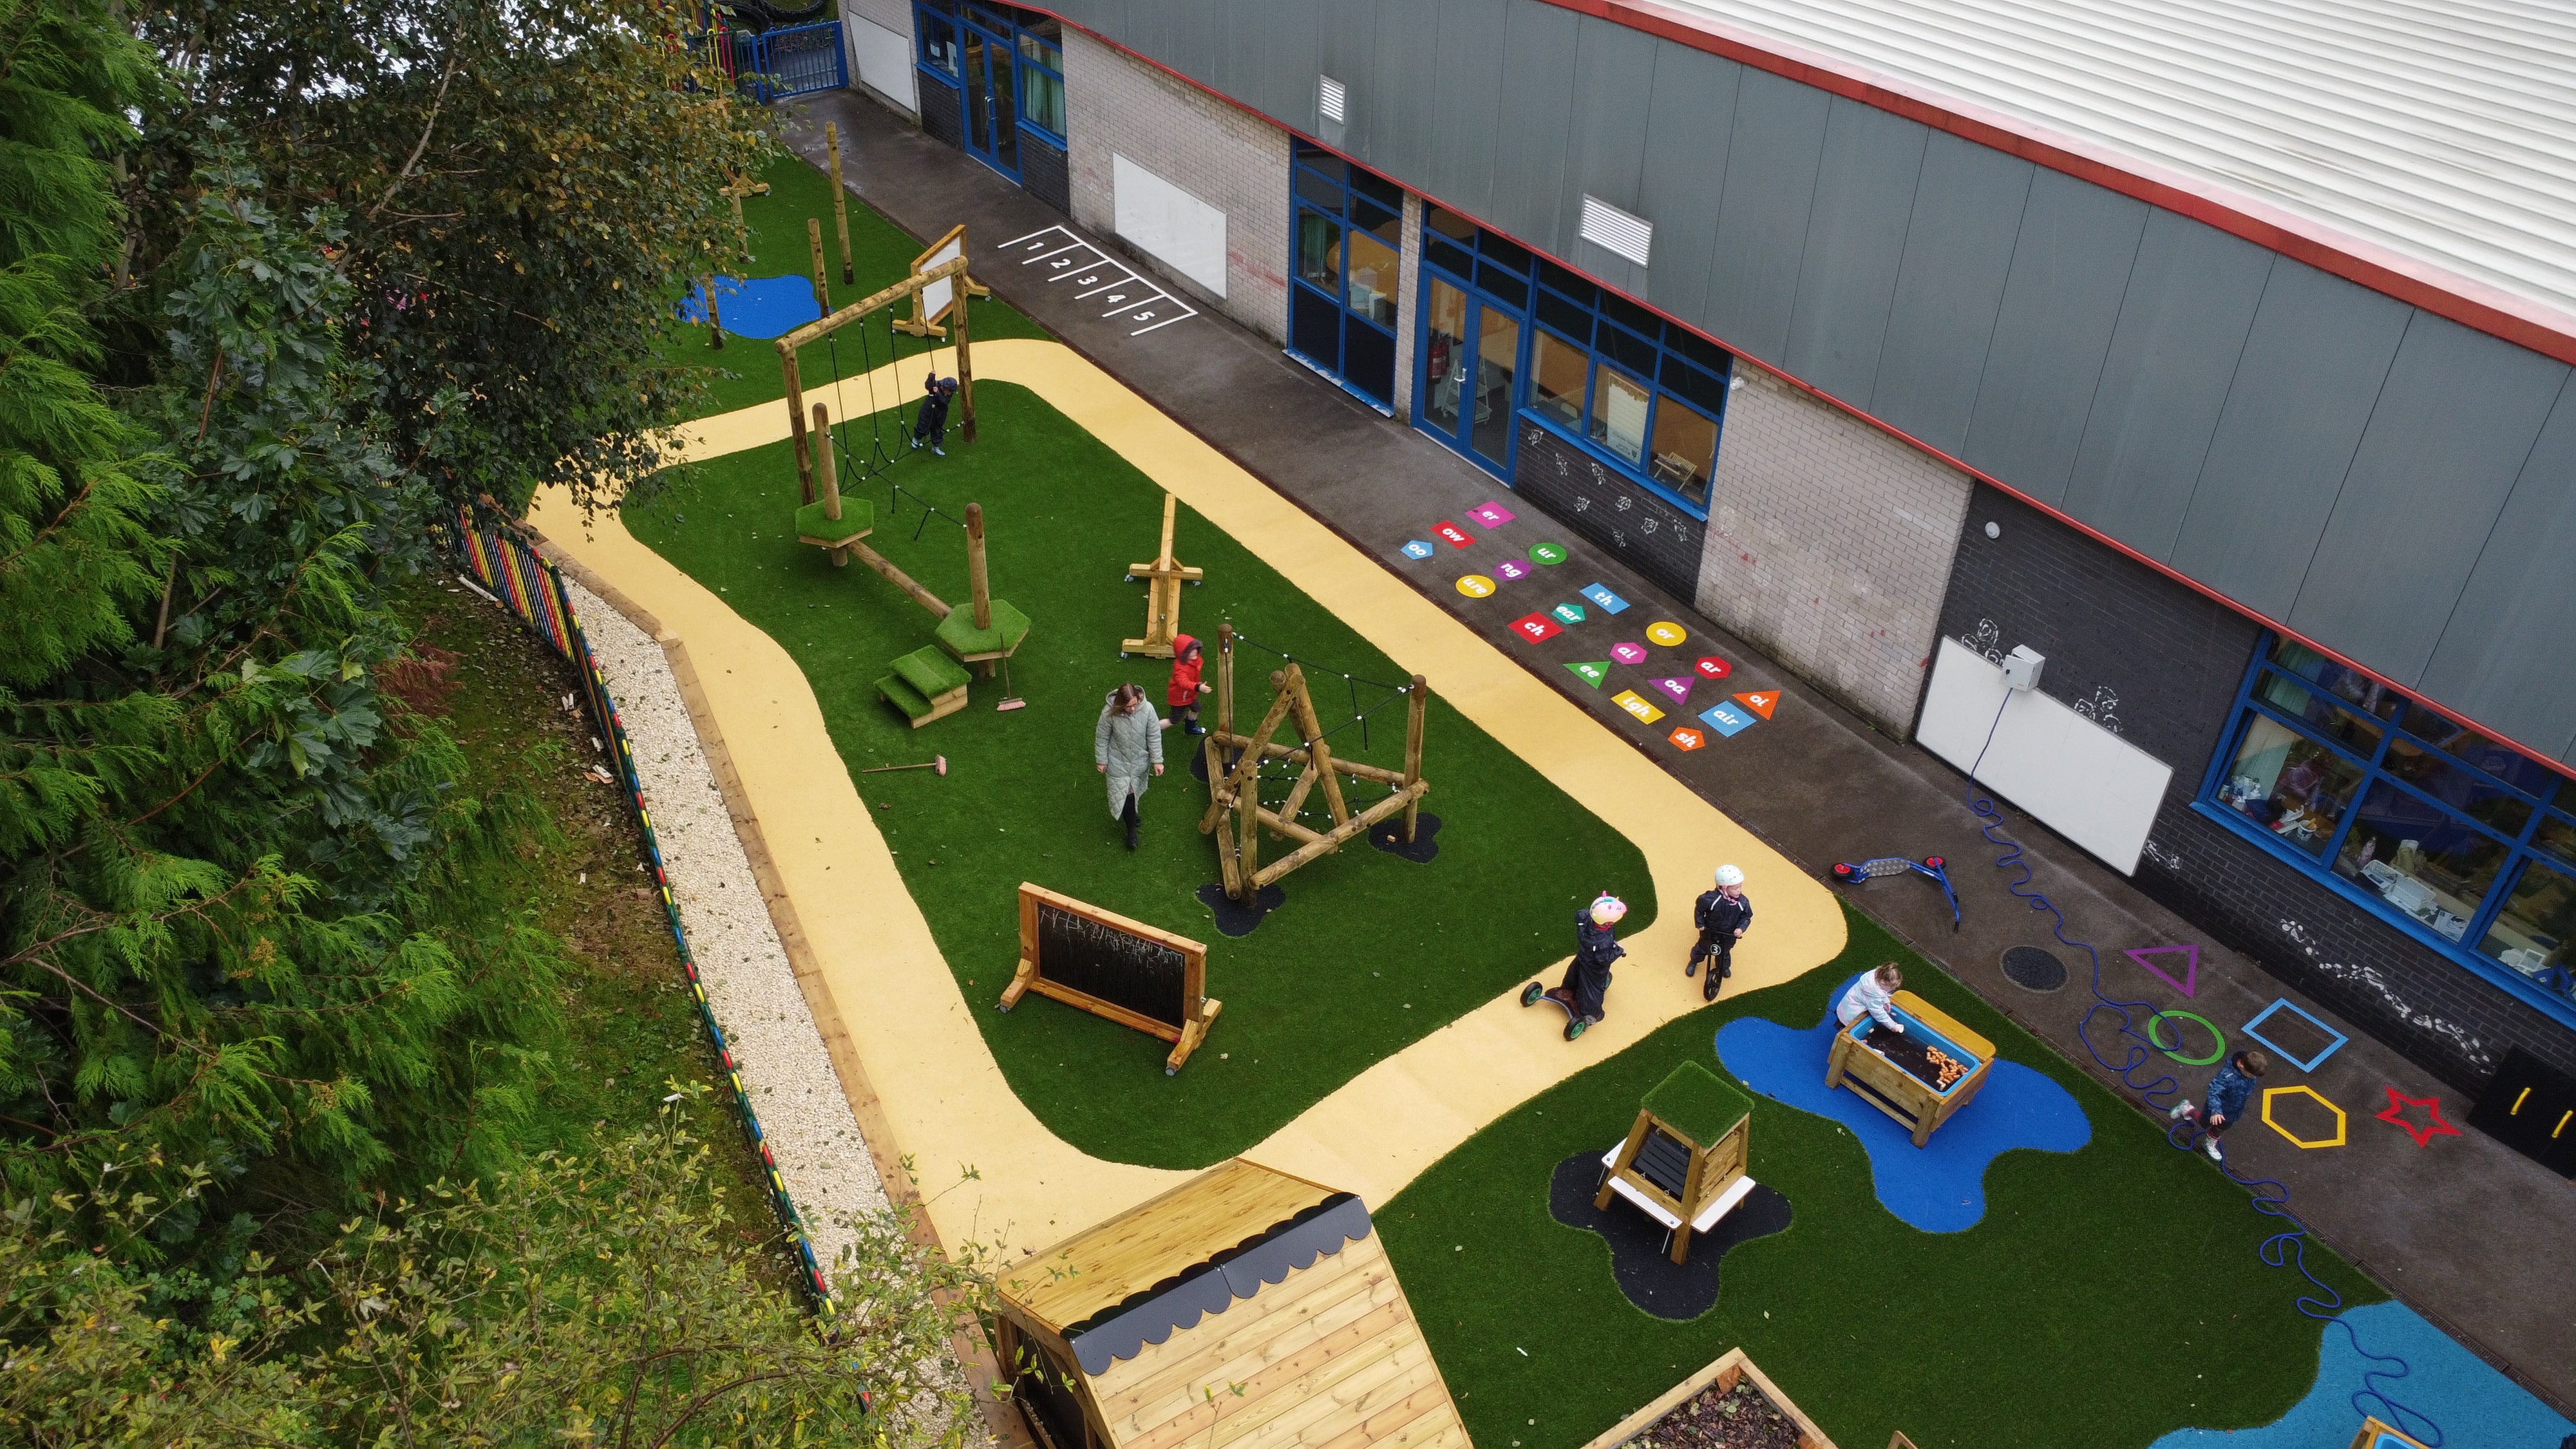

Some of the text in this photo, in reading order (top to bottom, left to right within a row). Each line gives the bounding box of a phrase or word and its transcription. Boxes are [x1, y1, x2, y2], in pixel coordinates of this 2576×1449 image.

[1027, 242, 1045, 251] 1
[1050, 258, 1071, 269] 2
[1077, 276, 1098, 285] 3
[1107, 294, 1126, 303] 4
[1133, 311, 1155, 321] 5
[1482, 511, 1499, 520] er
[1442, 527, 1464, 542] ow
[1408, 543, 1426, 556] oo
[1538, 547, 1556, 559] ur
[1501, 563, 1522, 578] ng
[1463, 578, 1487, 594] ure
[1595, 591, 1613, 607] th
[1555, 605, 1581, 621] ear
[1524, 622, 1544, 636] ch
[1656, 628, 1675, 639] or
[1617, 646, 1638, 659] ai
[1579, 664, 1600, 678] ee
[1700, 661, 1721, 673] ar
[1664, 679, 1686, 695] oa
[1622, 696, 1650, 717] igh
[1749, 693, 1769, 707] oi
[1713, 710, 1739, 726] air
[1675, 732, 1696, 748] sh
[1712, 945, 1719, 954] 3
